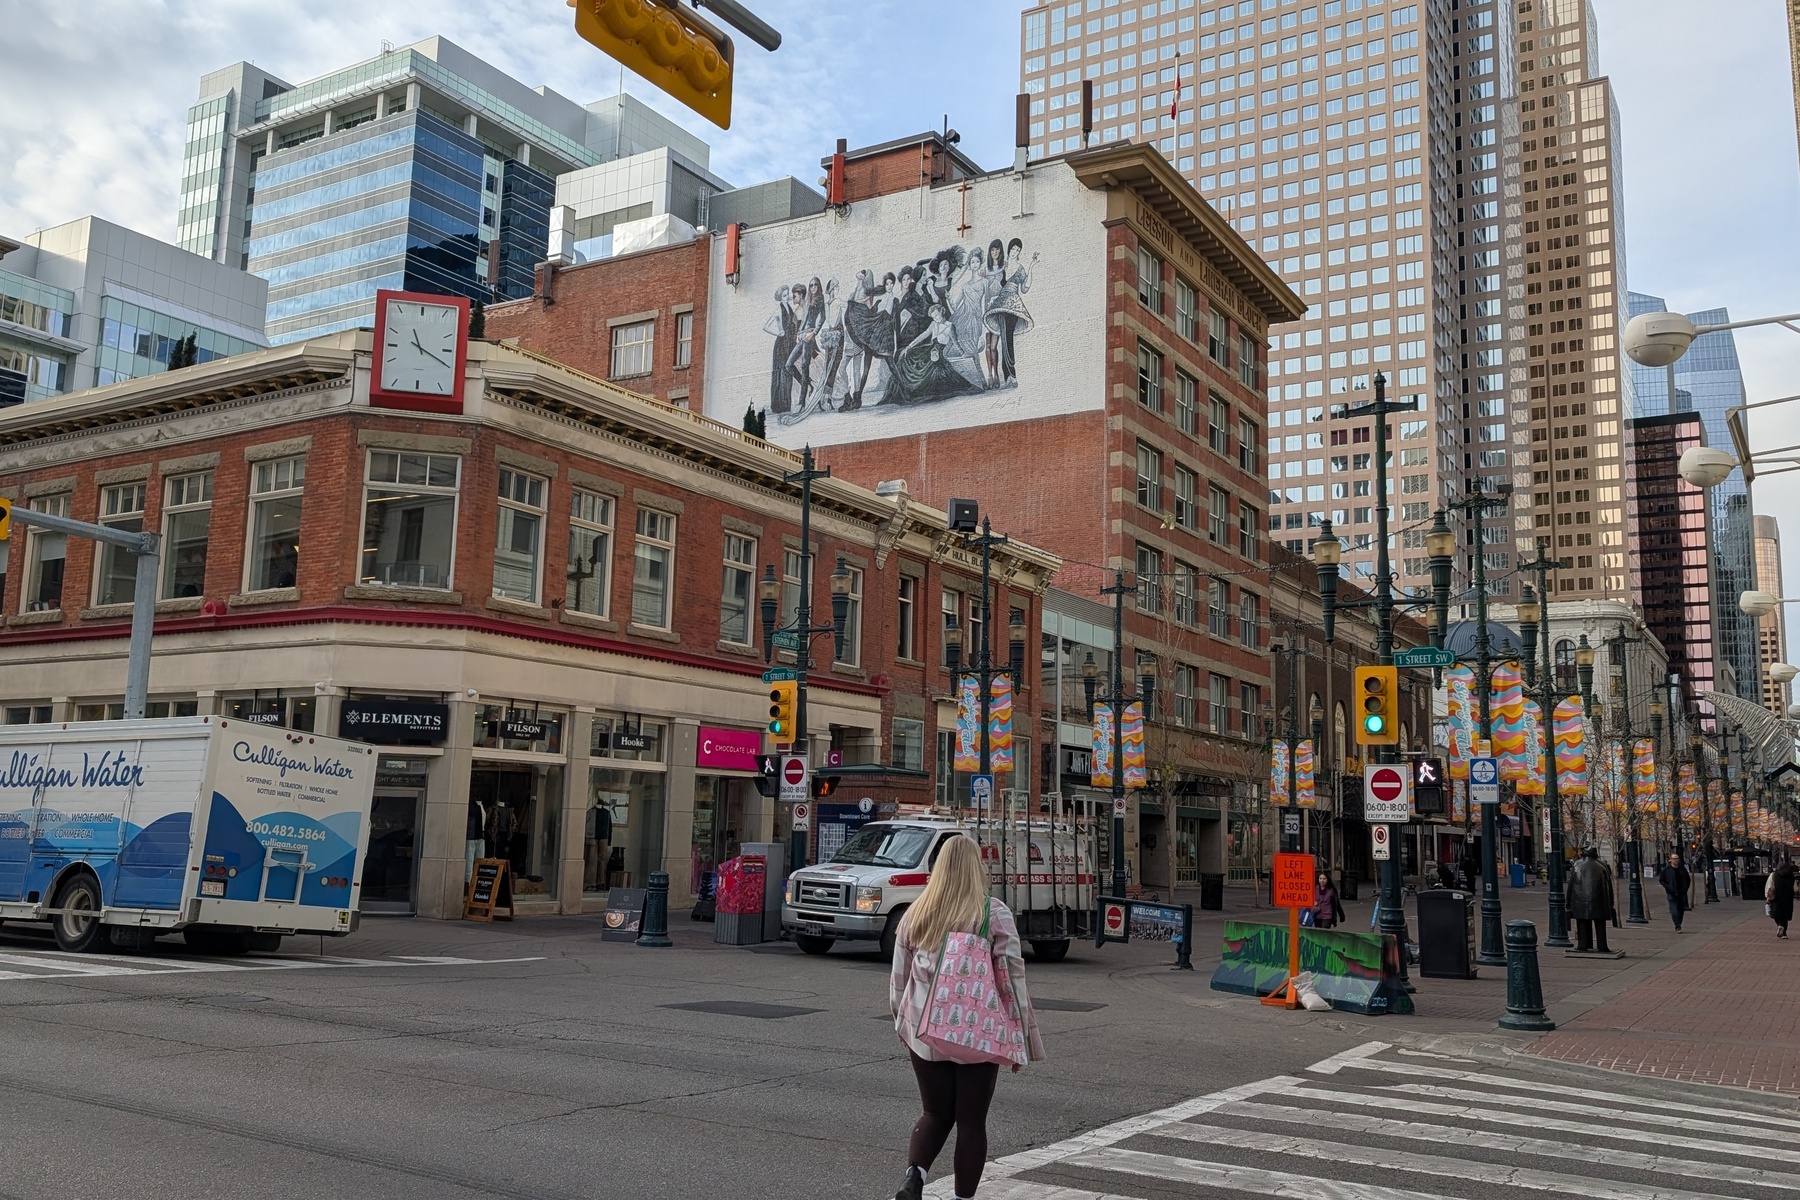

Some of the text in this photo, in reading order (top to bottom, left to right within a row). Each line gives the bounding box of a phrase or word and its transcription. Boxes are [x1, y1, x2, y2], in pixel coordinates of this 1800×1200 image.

[1137, 202, 1174, 254] LEESON
[1180, 250, 1194, 267] AND
[1237, 295, 1263, 333] BLOCK
[952, 550, 969, 563] HULL
[1399, 656, 1403, 664] 1
[1406, 655, 1431, 663] STREET
[248, 714, 279, 722] FILSON
[361, 712, 442, 726] ELEMENTS
[507, 723, 541, 734] FILSON
[715, 744, 745, 754] CHOCOLATE
[233, 741, 354, 780] Culligan Water
[82, 750, 145, 787] Water
[246, 776, 272, 785] SOFTENING
[279, 781, 303, 790] FILTRATION
[309, 786, 325, 794] WHOLE
[781, 786, 807, 794] 06:00-18:00
[257, 787, 326, 803] BOTTLED WATER COMMERCIAL
[71, 813, 95, 823] WHOLE
[95, 813, 114, 823] HOME
[246, 821, 326, 841] 800.482.5864
[1286, 822, 1298, 832] 30
[54, 828, 94, 839] COMMERCIAL
[261, 838, 309, 850] culligan.com
[1284, 859, 1304, 868] LEFT
[1283, 871, 1305, 880] LANE
[1278, 882, 1311, 891] CLOSED
[1281, 893, 1309, 902] AHEAD
[1133, 906, 1161, 917] WELCOME
